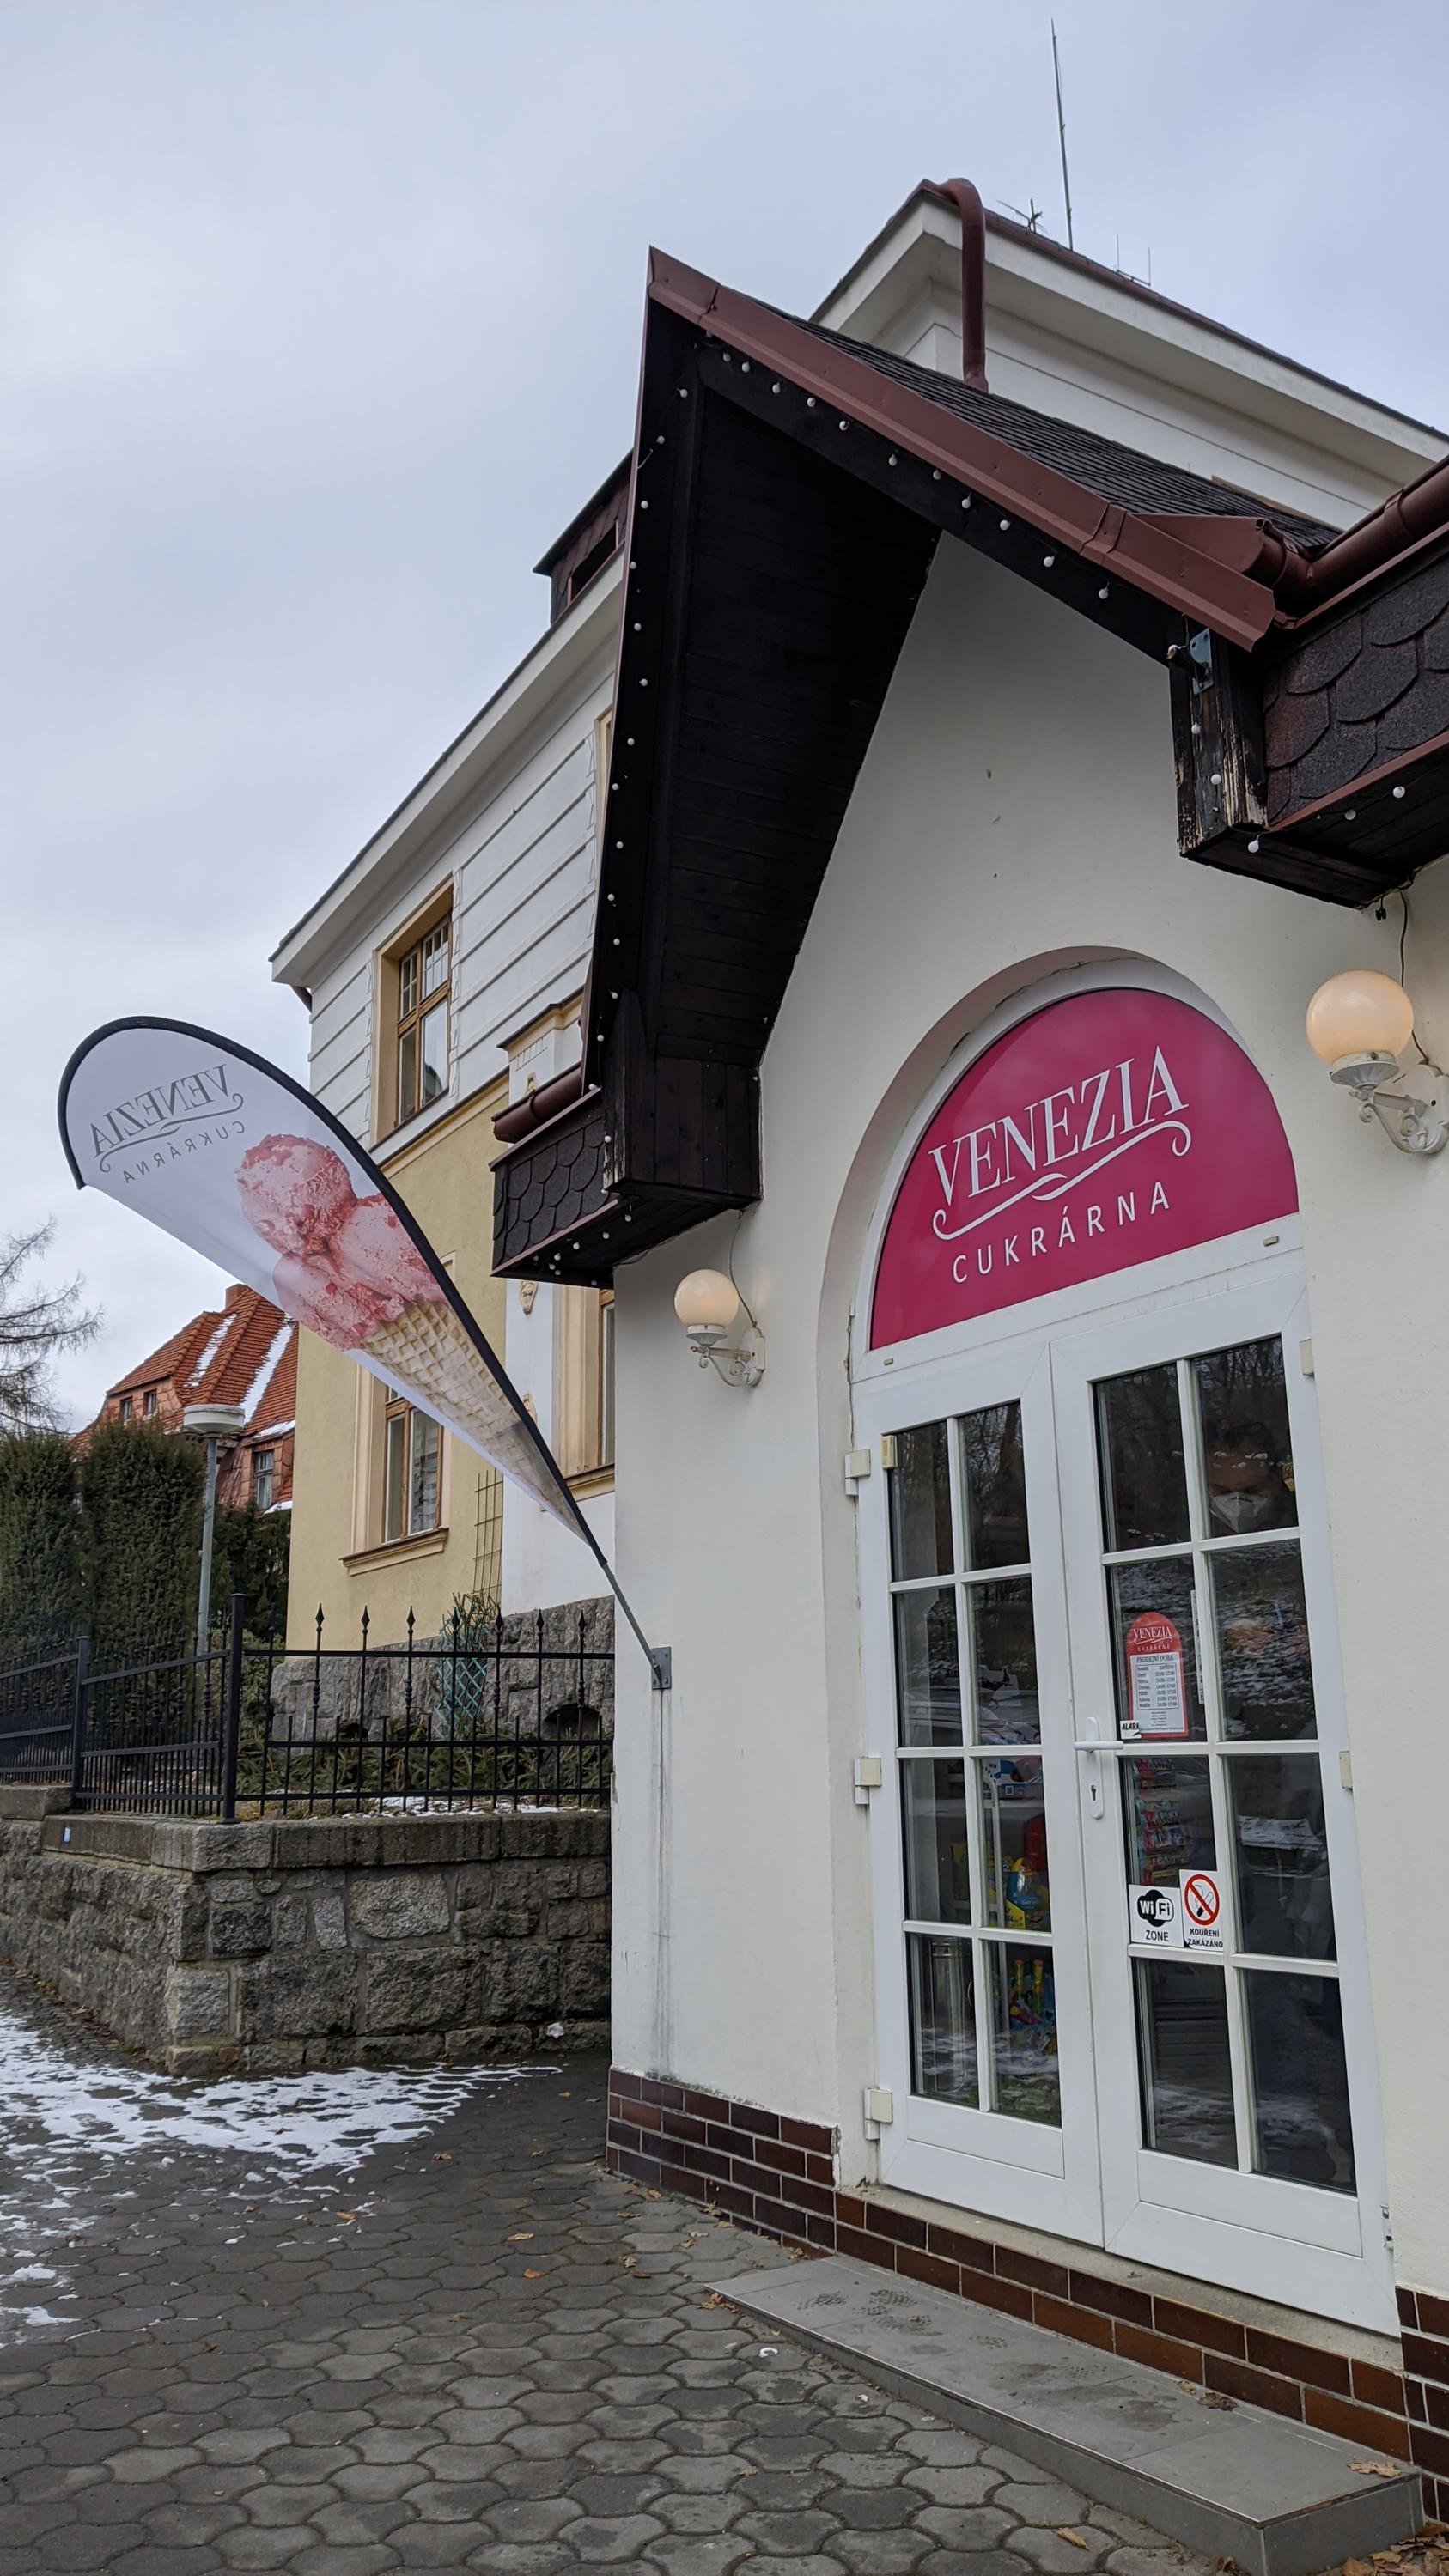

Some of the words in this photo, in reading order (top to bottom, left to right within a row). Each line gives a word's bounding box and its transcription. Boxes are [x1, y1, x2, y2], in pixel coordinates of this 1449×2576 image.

[928, 1046, 1189, 1206] VENEZIA
[952, 1182, 1170, 1283] CUKRÁRNA
[1133, 1625, 1172, 1639] VENEZIA
[1145, 1929, 1169, 1941] ZONE
[1190, 1928, 1220, 1937] KOUŘENÍ
[1188, 1938, 1223, 1948] ZAKÁZÁNO
